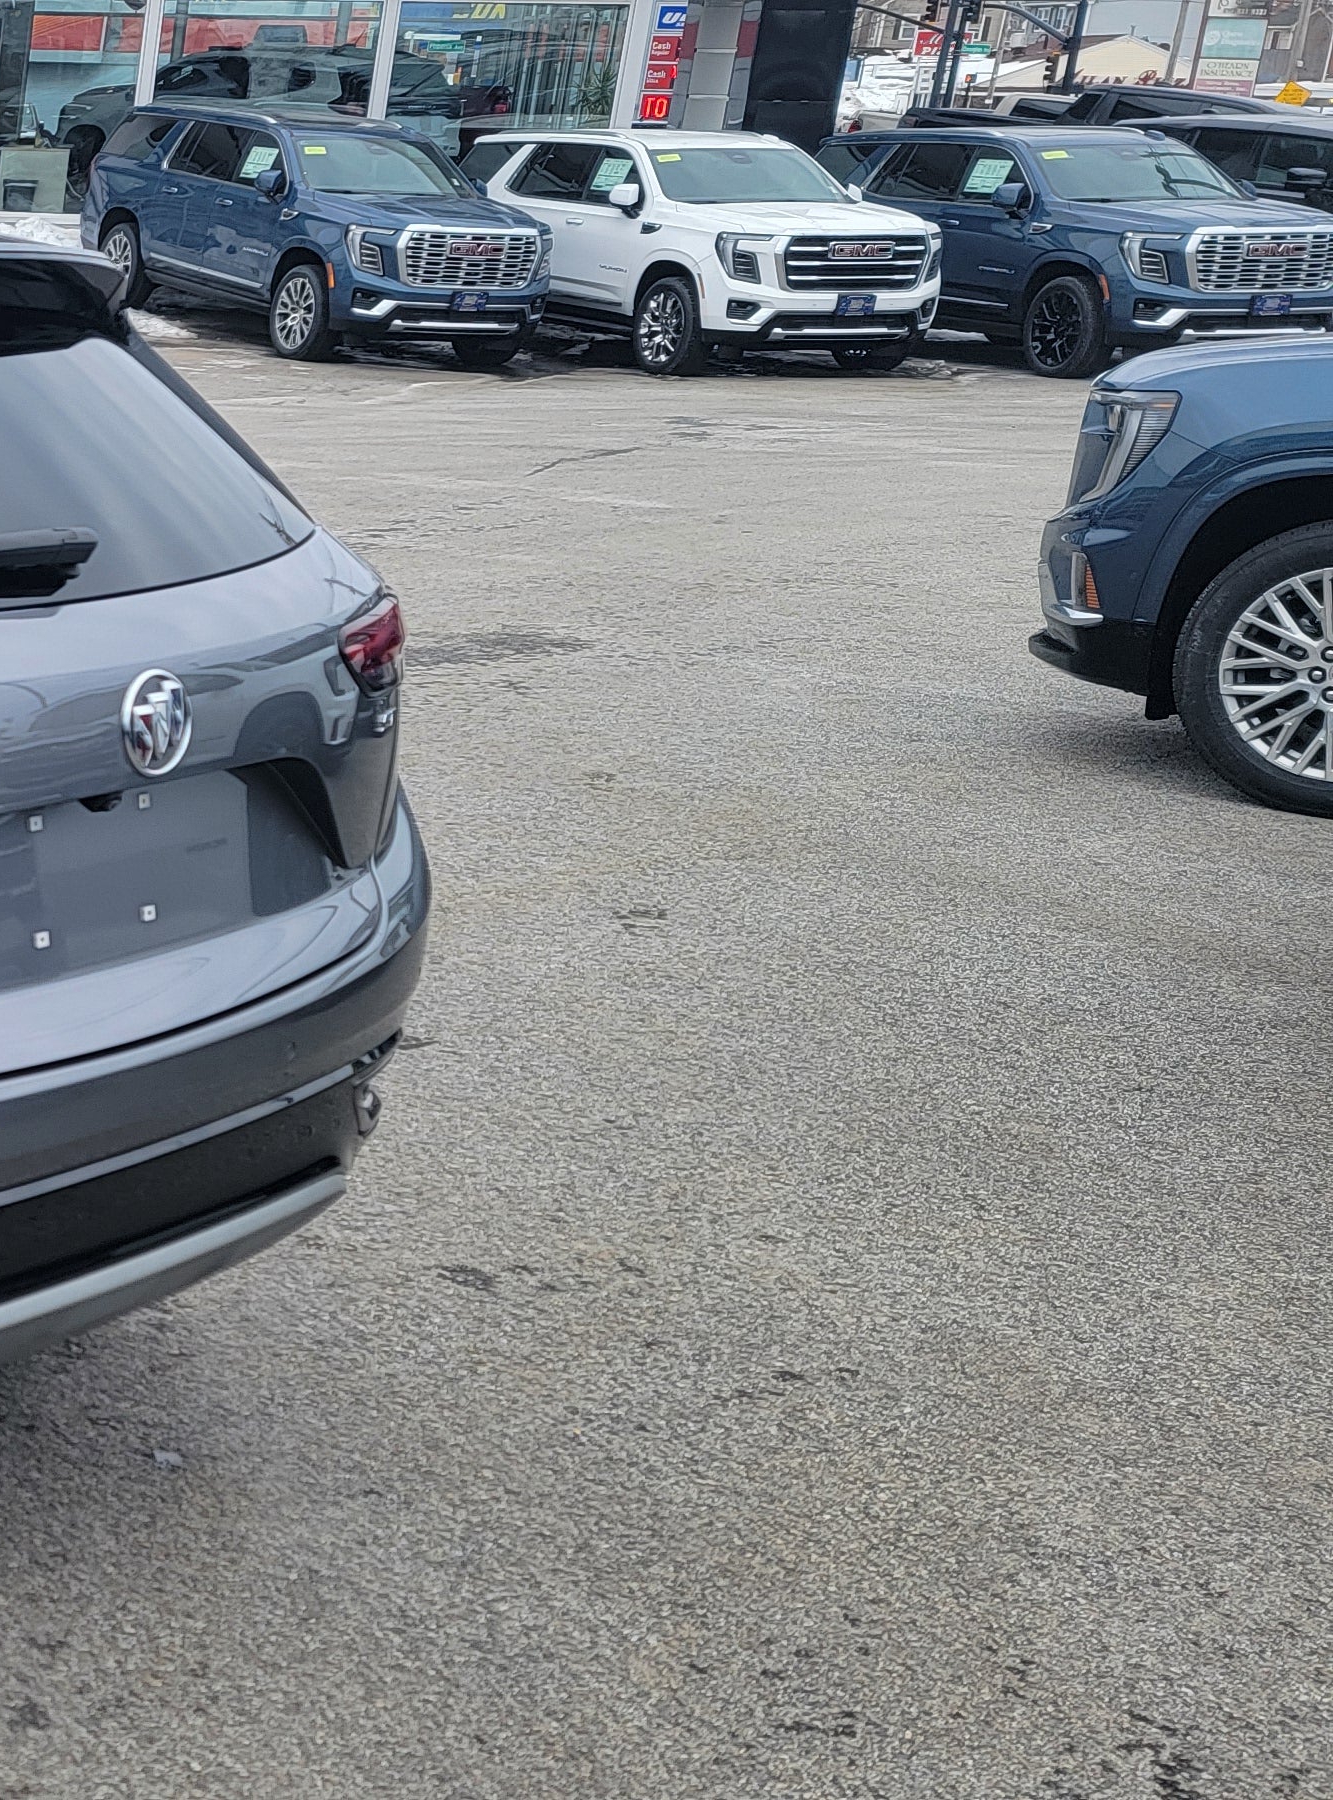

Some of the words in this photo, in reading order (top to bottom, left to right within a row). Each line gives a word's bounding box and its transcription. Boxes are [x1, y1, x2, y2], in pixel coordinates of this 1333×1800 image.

[652, 41, 671, 50] Cash
[1200, 69, 1254, 77] INSURANCE
[451, 243, 504, 256] GMC
[833, 244, 892, 256] GMC
[1249, 243, 1309, 256] GMC
